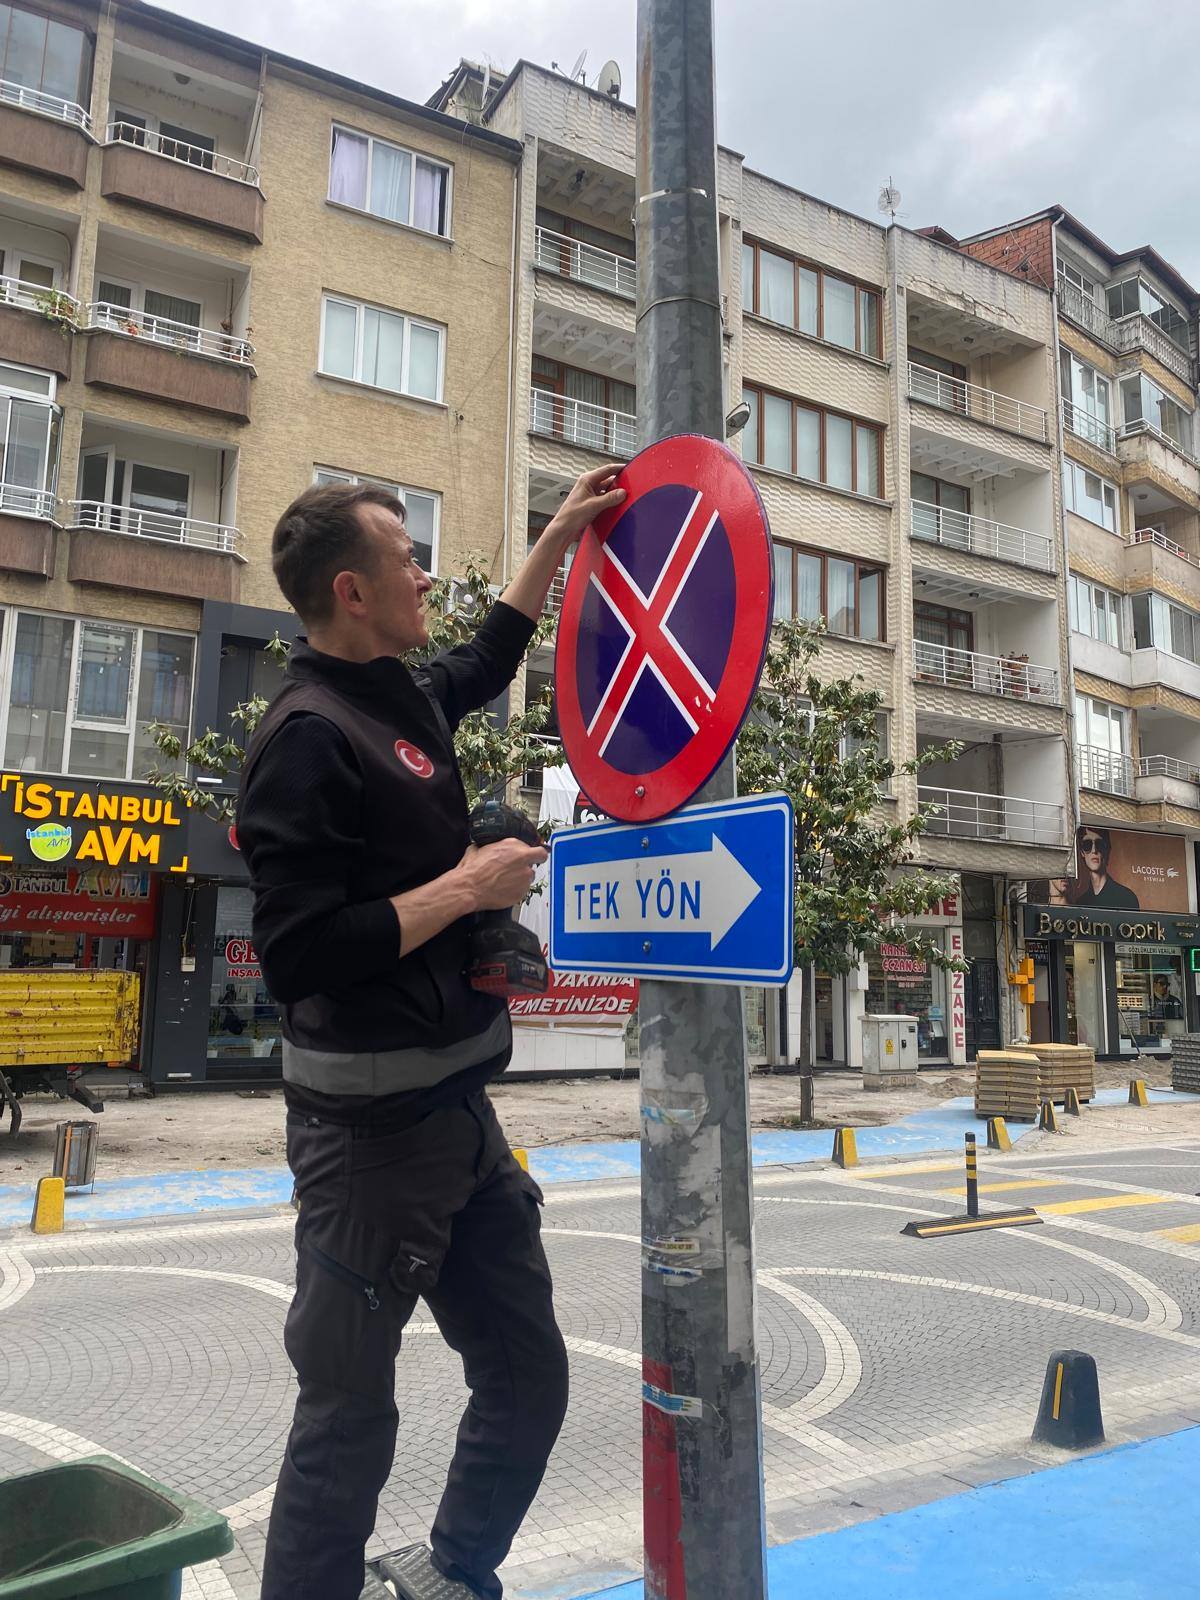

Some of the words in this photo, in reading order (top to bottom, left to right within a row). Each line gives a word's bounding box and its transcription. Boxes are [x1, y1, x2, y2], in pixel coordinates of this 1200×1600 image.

[75, 825, 161, 866] AVM
[1131, 865, 1165, 876] LACOSTE
[74, 869, 150, 899] AVM
[574, 880, 620, 920] TEK
[636, 868, 701, 920] YÖN
[1039, 911, 1113, 939] Begüm
[227, 967, 263, 979] İNŞAA
[552, 971, 635, 989] YAKINDA
[508, 994, 634, 1014] İZMETİNİZDE
